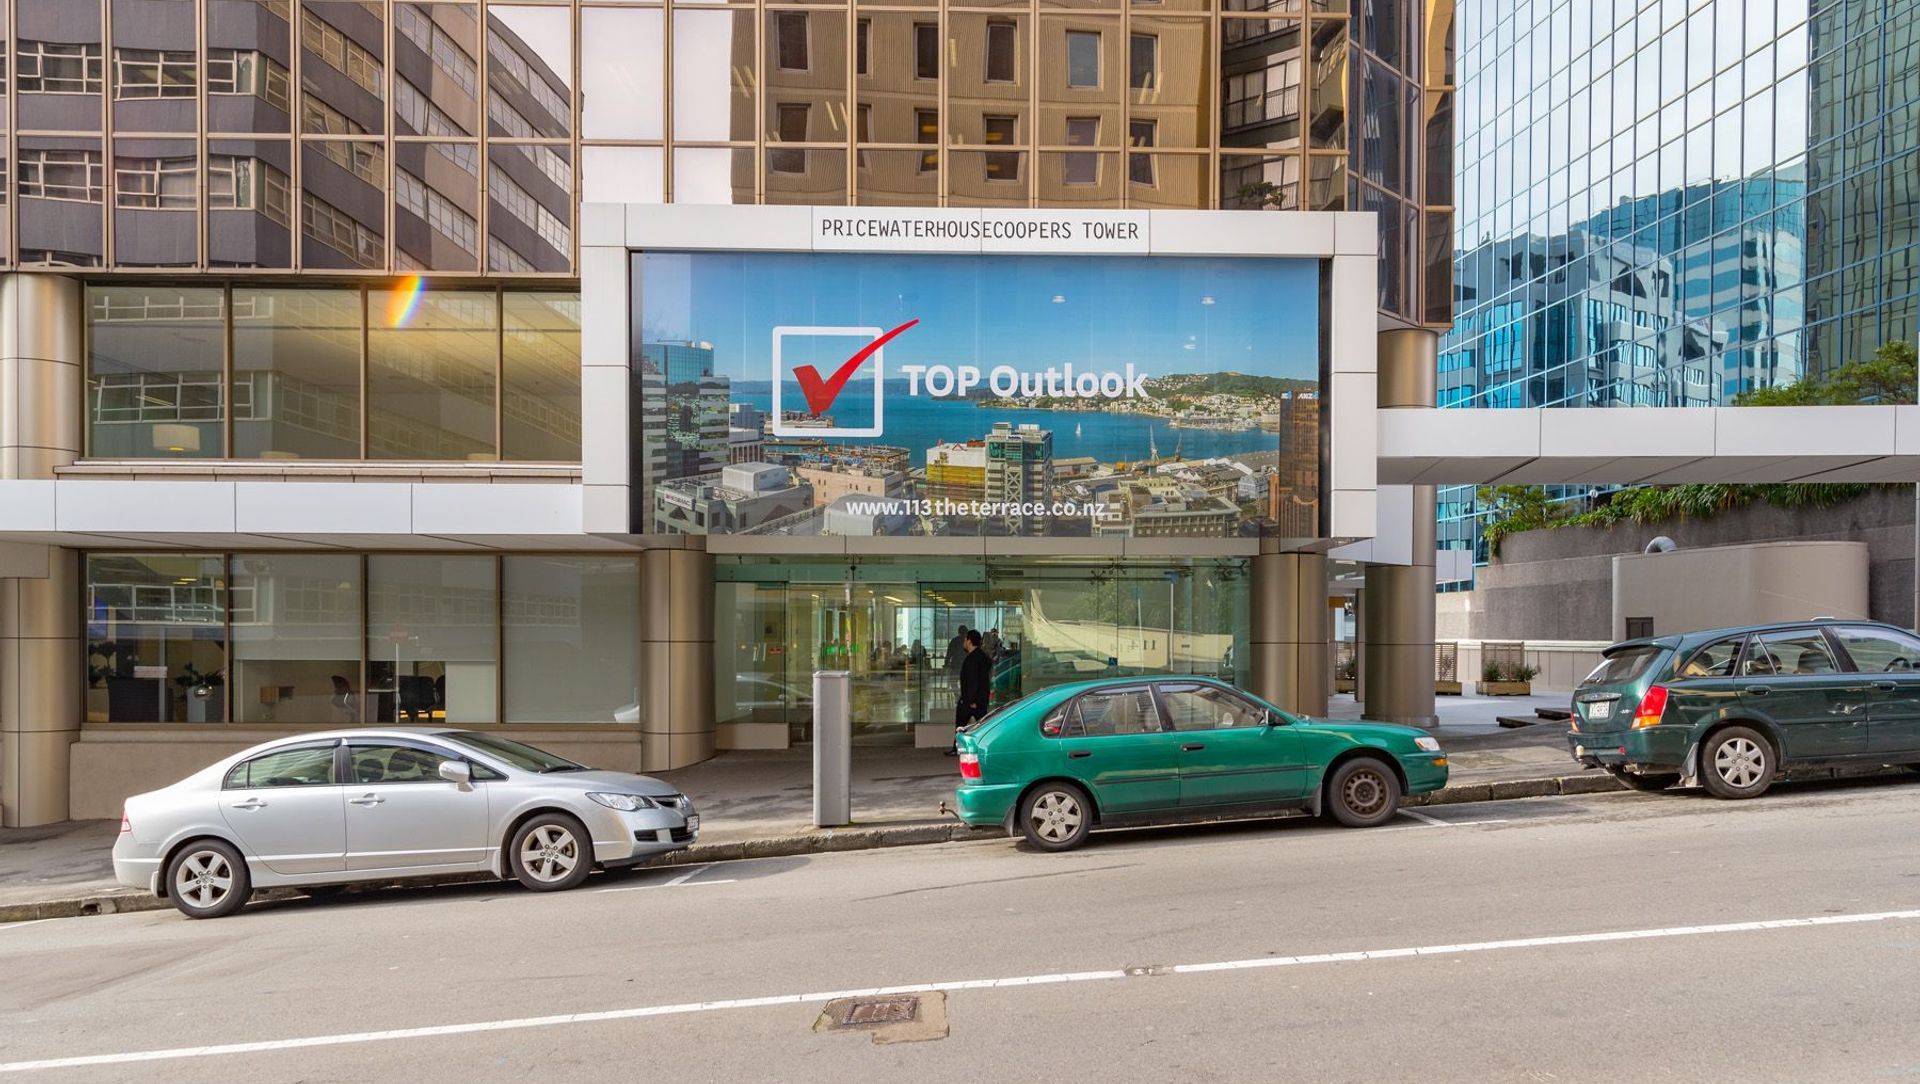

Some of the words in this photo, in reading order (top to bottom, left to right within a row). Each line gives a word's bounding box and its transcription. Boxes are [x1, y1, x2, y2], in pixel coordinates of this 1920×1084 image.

[822, 219, 1072, 239] PRICEWATERHOUSECOOPERS
[1082, 221, 1139, 240] TOWER
[902, 364, 981, 397] TOP
[989, 362, 1150, 398] Outlook
[846, 497, 1106, 517] www.113theterrace.co.nz
